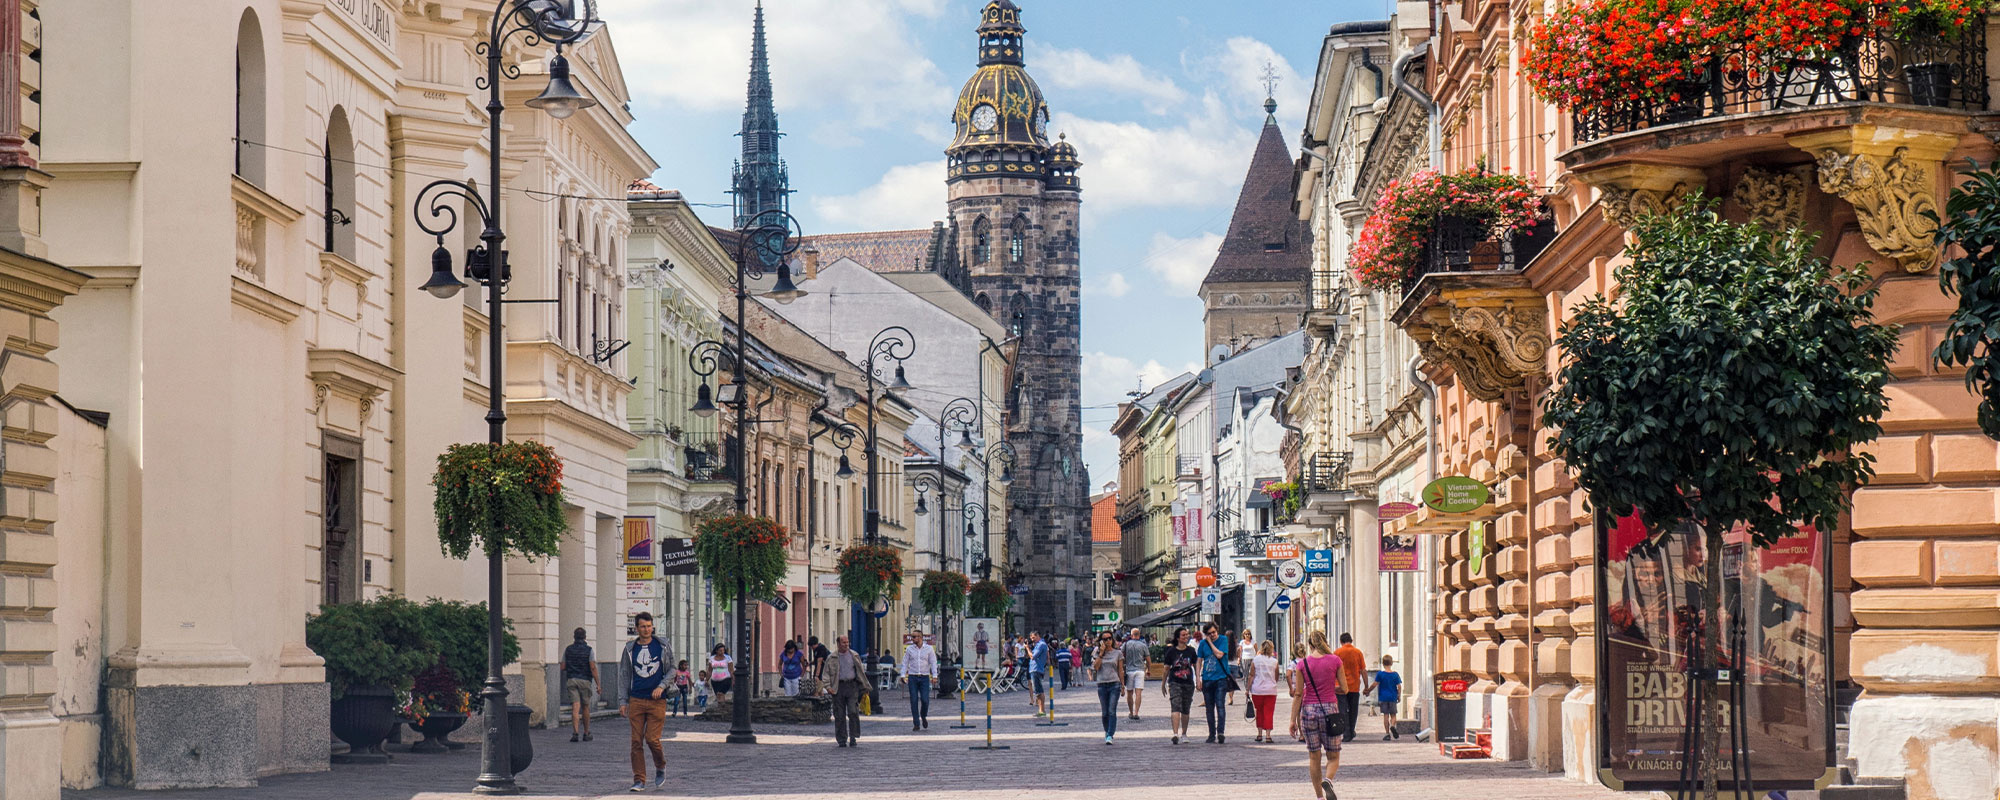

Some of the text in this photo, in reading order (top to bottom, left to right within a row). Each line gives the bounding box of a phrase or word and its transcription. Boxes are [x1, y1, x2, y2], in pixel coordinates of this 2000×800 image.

[664, 548, 696, 560] TEXTILNÁ
[1627, 761, 1634, 770] V
[1637, 759, 1673, 770] KINÁCH
